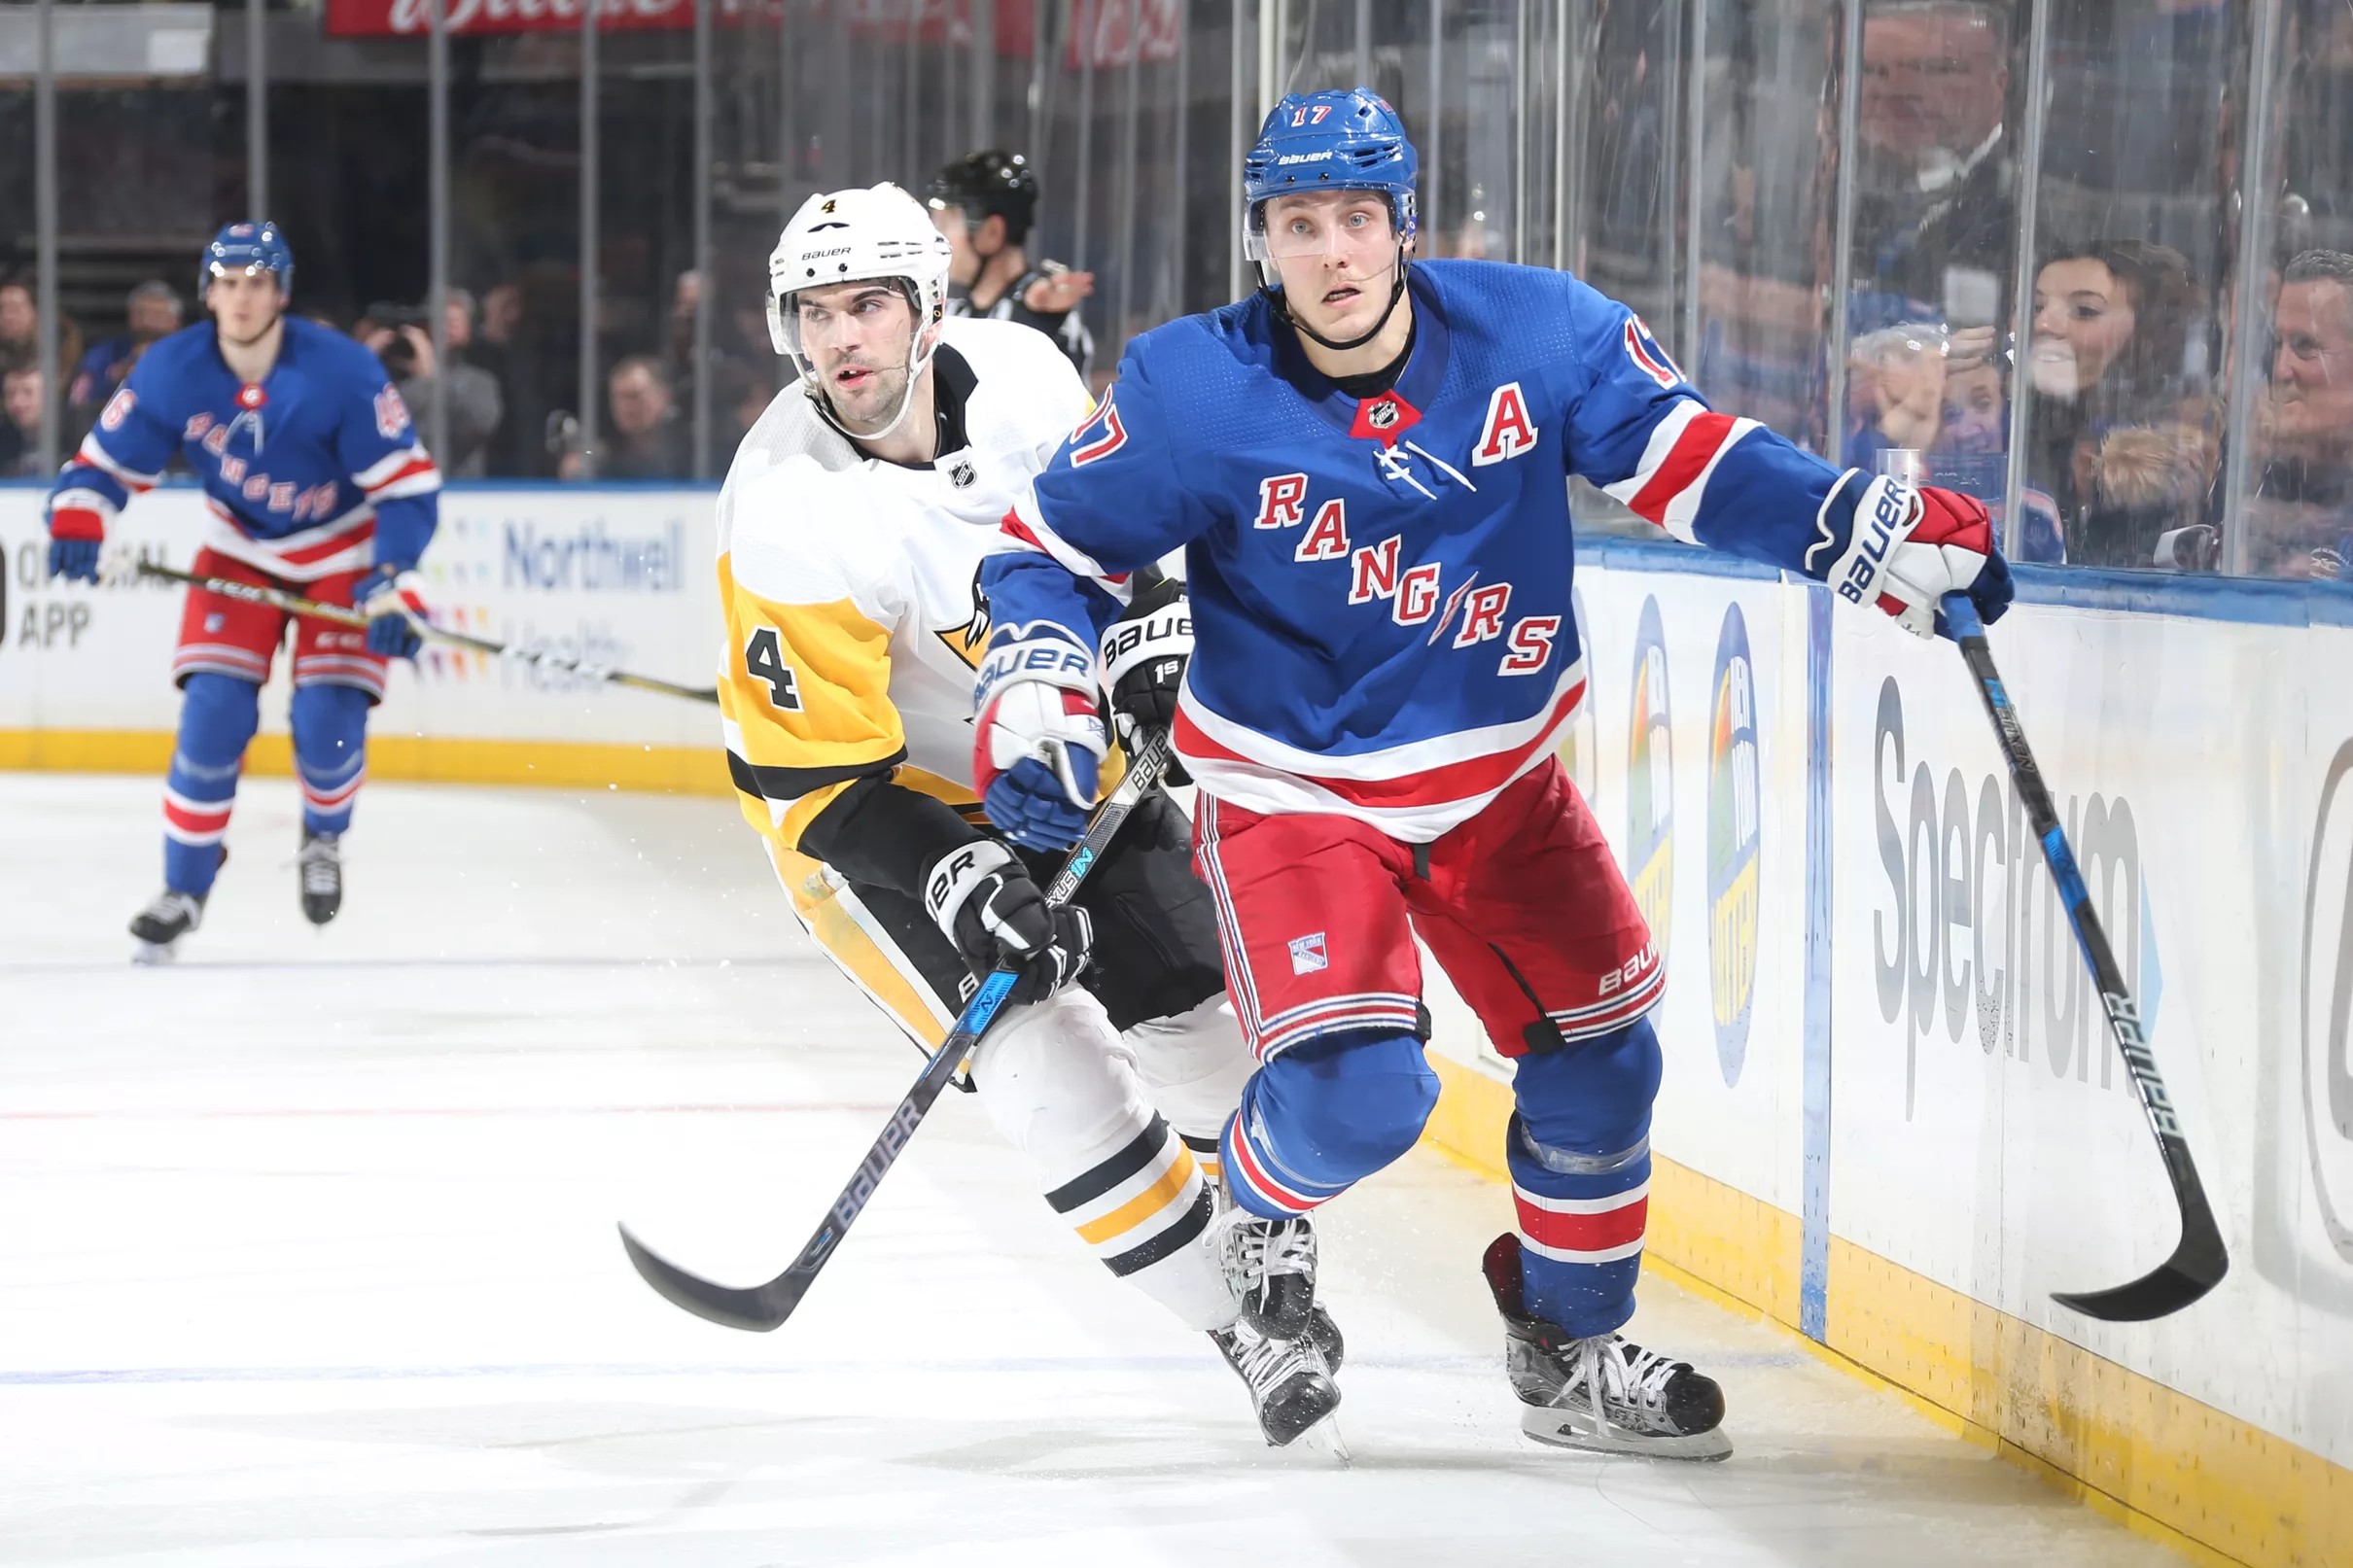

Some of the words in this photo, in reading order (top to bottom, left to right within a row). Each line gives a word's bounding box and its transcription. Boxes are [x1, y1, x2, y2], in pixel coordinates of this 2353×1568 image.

[1278, 150, 1333, 165] BAUER
[1290, 105, 1332, 127] 17
[821, 198, 836, 214] 4
[801, 247, 852, 261] BAUER
[1070, 382, 1128, 469] 17
[1472, 382, 1538, 467] A
[501, 516, 684, 591] Northwell
[1839, 478, 1907, 604] BAUER
[18, 603, 90, 647] APP
[744, 624, 805, 713] 4
[1874, 675, 2141, 1123] Spectrum
[2103, 992, 2186, 1138] BAUER
[833, 1097, 923, 1232] BAUER
